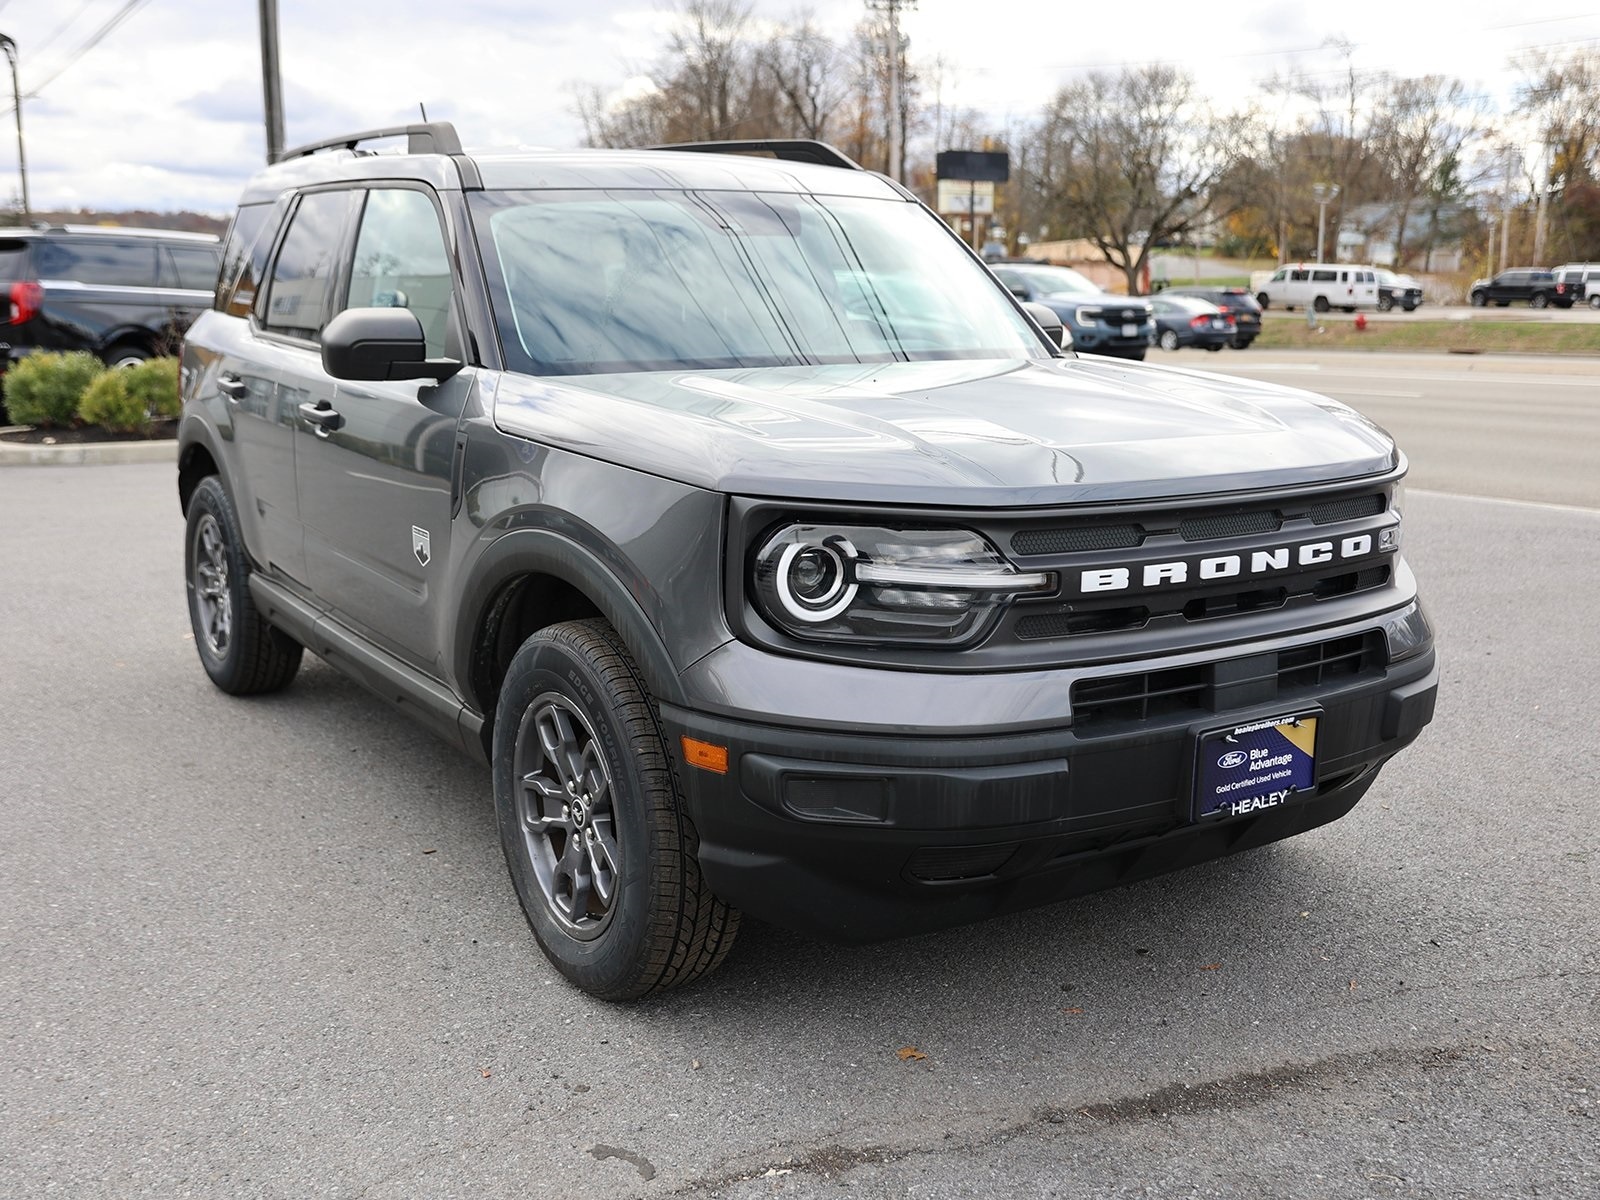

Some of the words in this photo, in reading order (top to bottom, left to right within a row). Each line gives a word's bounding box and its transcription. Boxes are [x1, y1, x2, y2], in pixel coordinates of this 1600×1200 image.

[1080, 534, 1372, 593] BRONCO
[567, 669, 594, 705] EDGE
[596, 711, 626, 792] TOURING
[1234, 717, 1295, 735] healeybrothers.com
[1221, 752, 1244, 767] Ford
[1249, 753, 1293, 772] Advantage
[1250, 748, 1269, 760] Blue
[1215, 784, 1231, 794] Gold
[1231, 777, 1256, 790] Certified
[1256, 774, 1271, 784] Used
[1272, 769, 1292, 779] Vehicle
[1231, 790, 1288, 816] HEALEY
